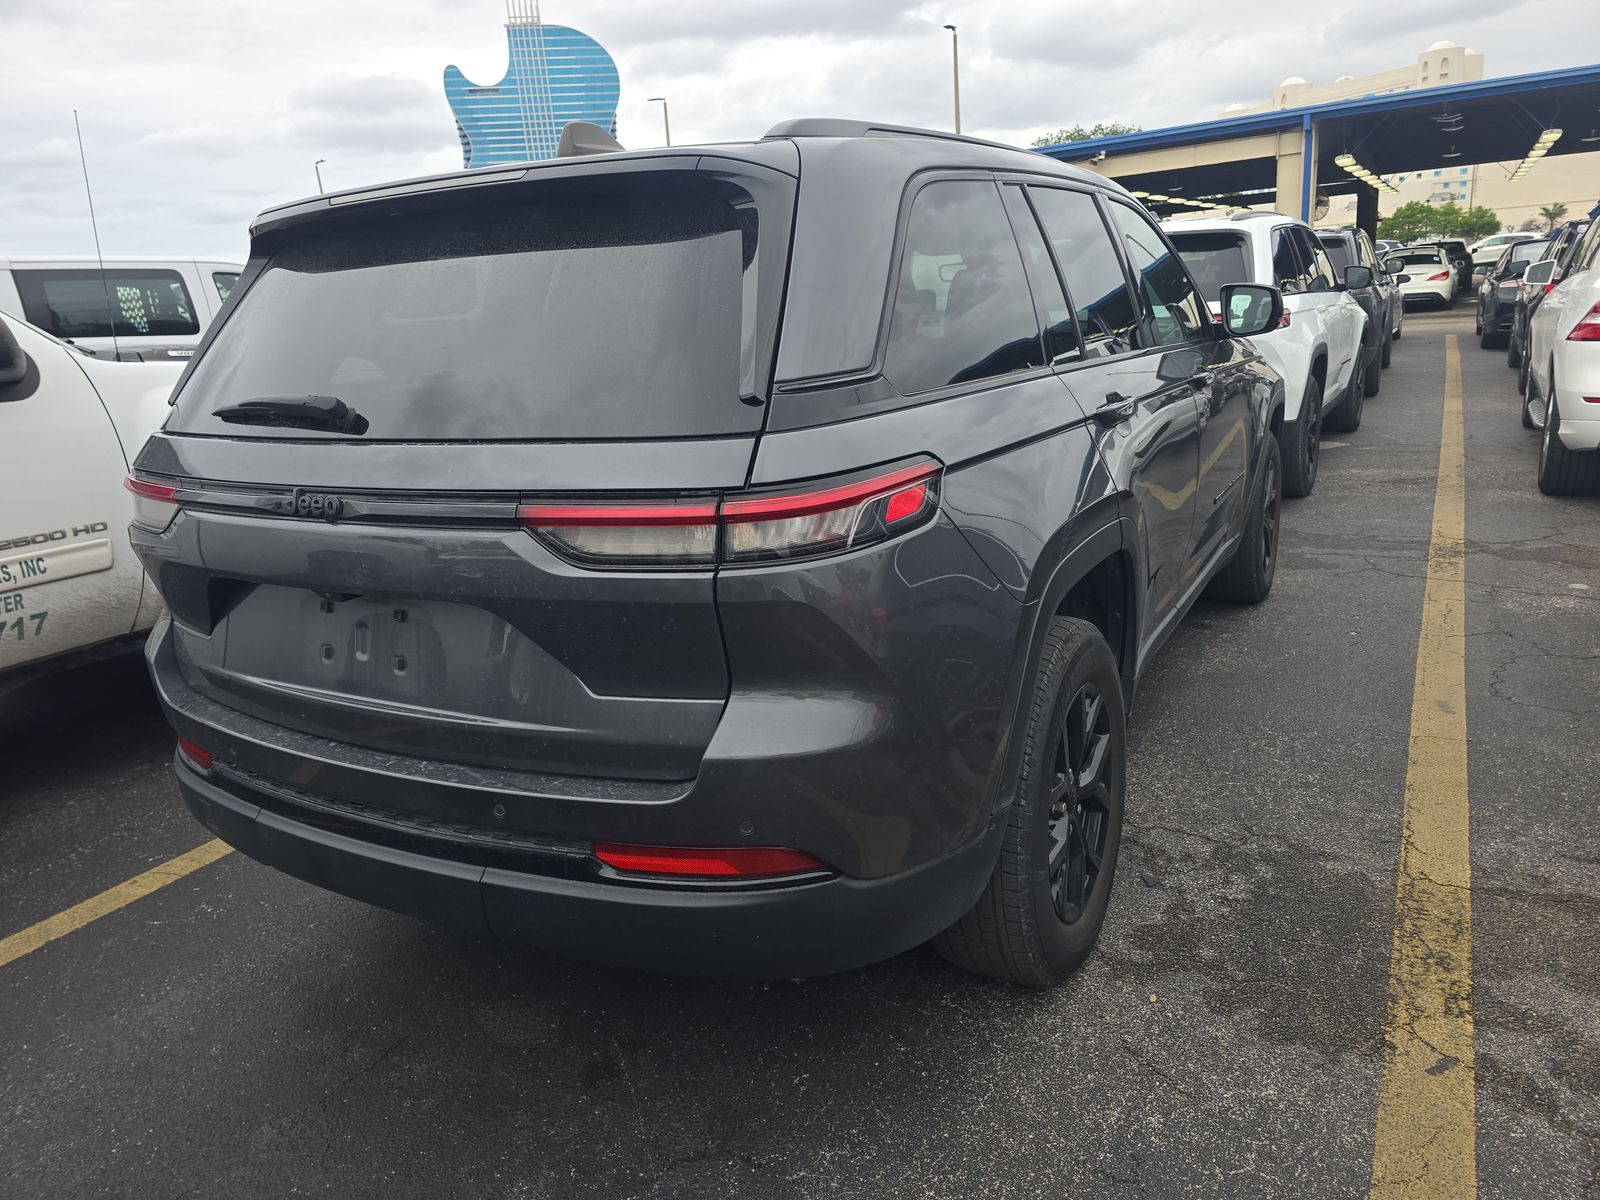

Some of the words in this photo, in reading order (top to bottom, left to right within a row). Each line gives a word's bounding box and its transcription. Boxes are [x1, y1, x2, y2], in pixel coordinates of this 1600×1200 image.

[281, 487, 344, 525] Jeep
[0, 529, 66, 551] 2500
[72, 521, 108, 536] HD
[19, 557, 47, 578] INC
